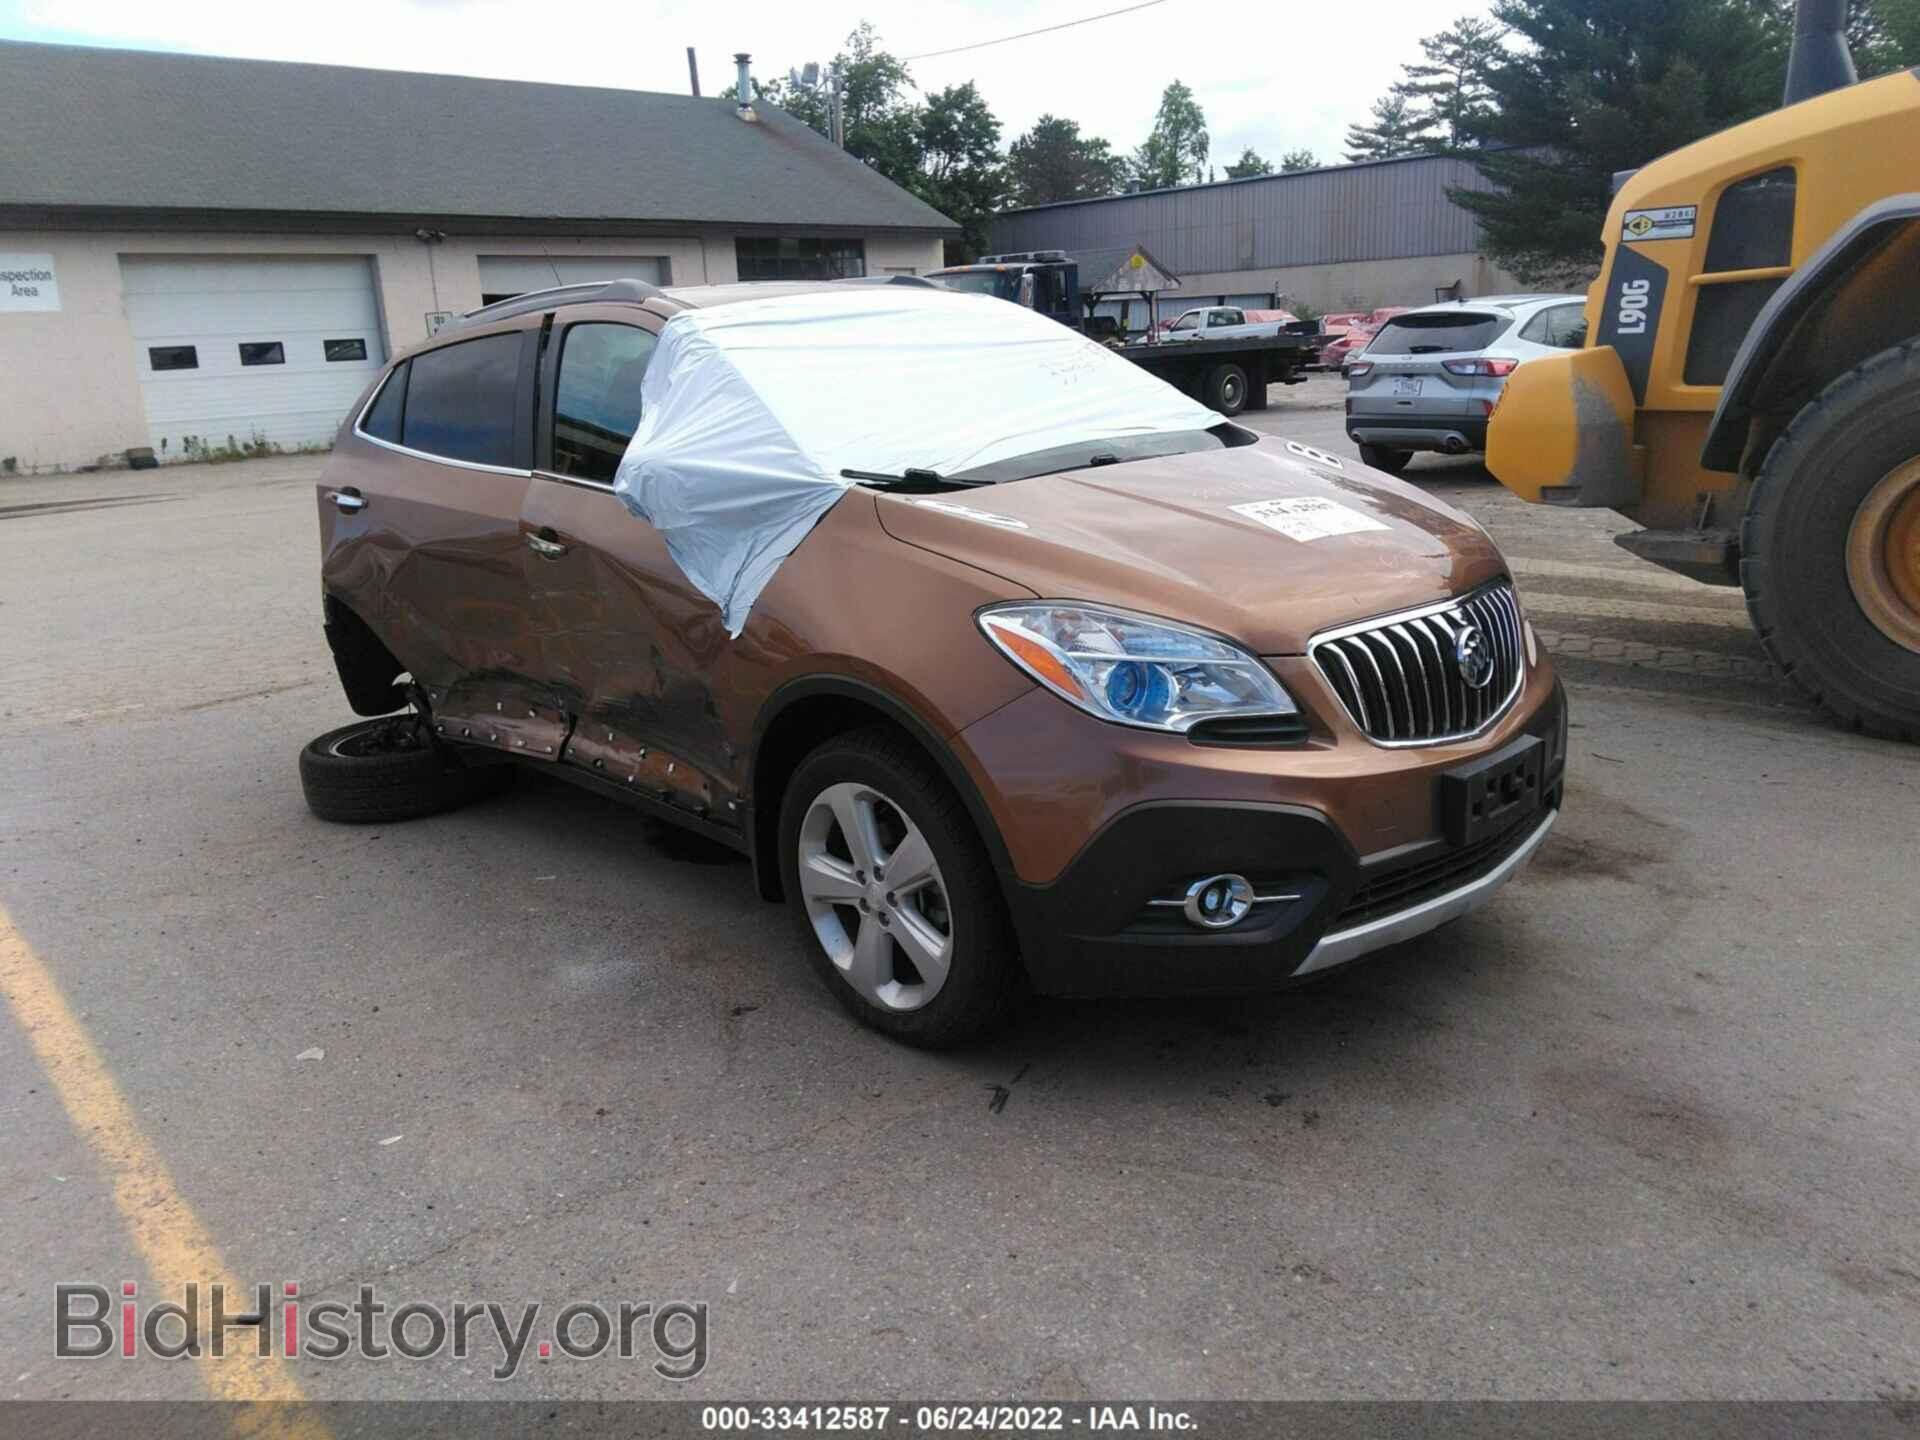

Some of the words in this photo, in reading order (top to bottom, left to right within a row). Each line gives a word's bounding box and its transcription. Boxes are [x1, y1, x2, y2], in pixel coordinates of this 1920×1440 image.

[0, 269, 52, 283] spection
[11, 284, 39, 297] Area
[1617, 279, 1650, 334] L90G
